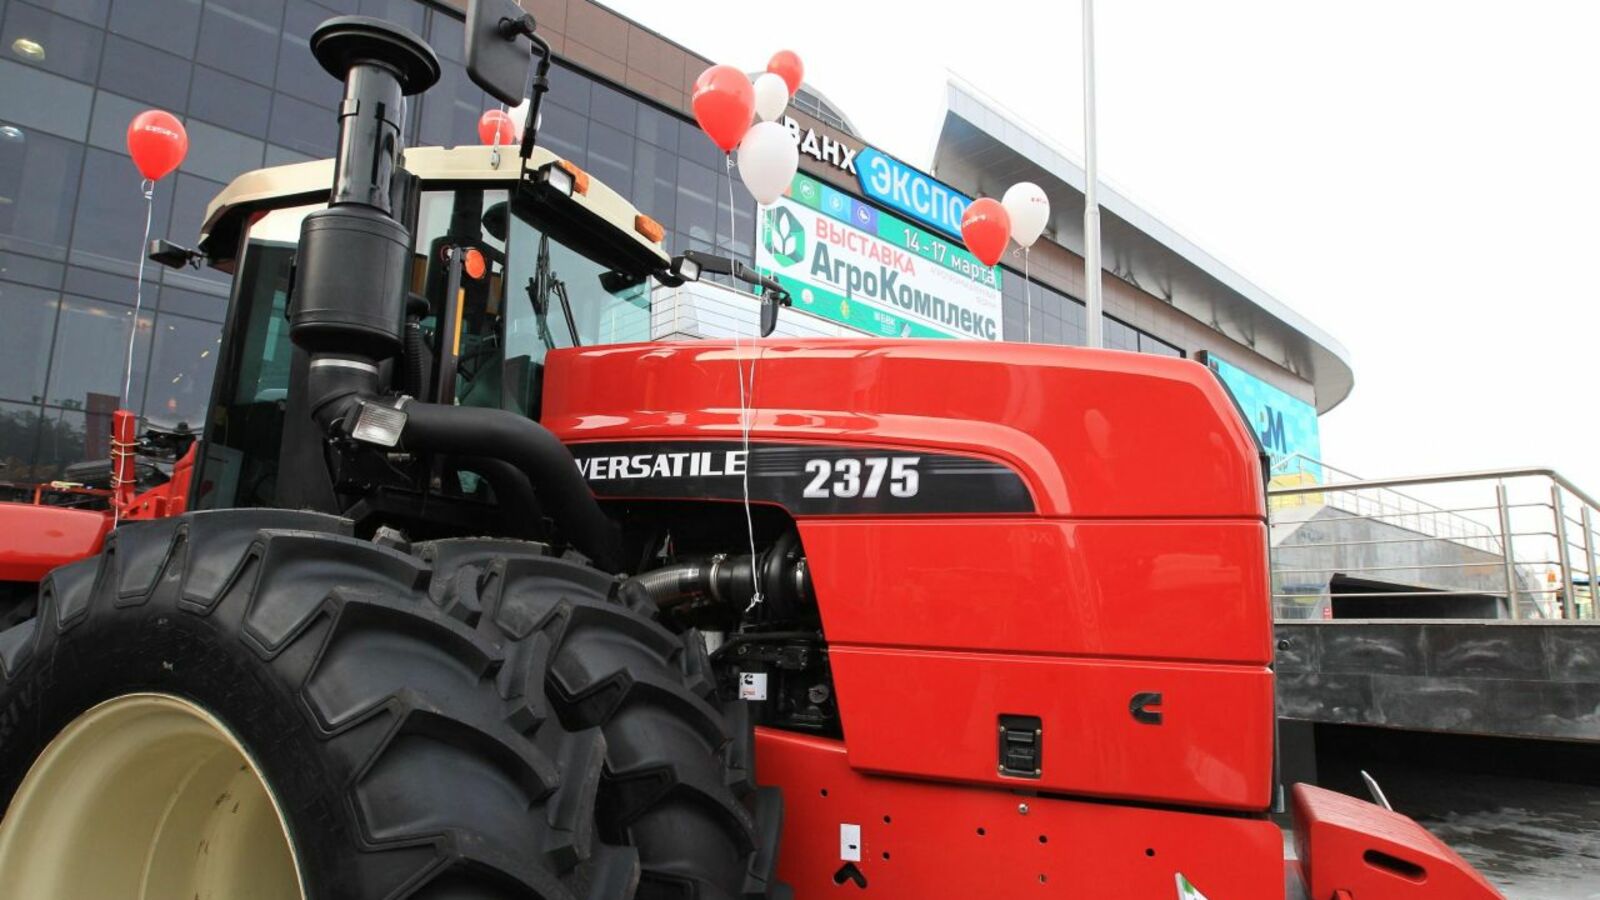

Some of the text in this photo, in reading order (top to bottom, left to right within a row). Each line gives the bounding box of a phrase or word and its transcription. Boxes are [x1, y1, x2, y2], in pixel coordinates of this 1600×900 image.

[782, 115, 857, 176] ВДНХ
[870, 156, 967, 234] ЭКСПО
[815, 217, 917, 277] ВЫСТАВКА
[951, 255, 996, 285] марта
[810, 242, 997, 341] АгроКомплекс
[574, 450, 922, 499] VERSATILE 2375
